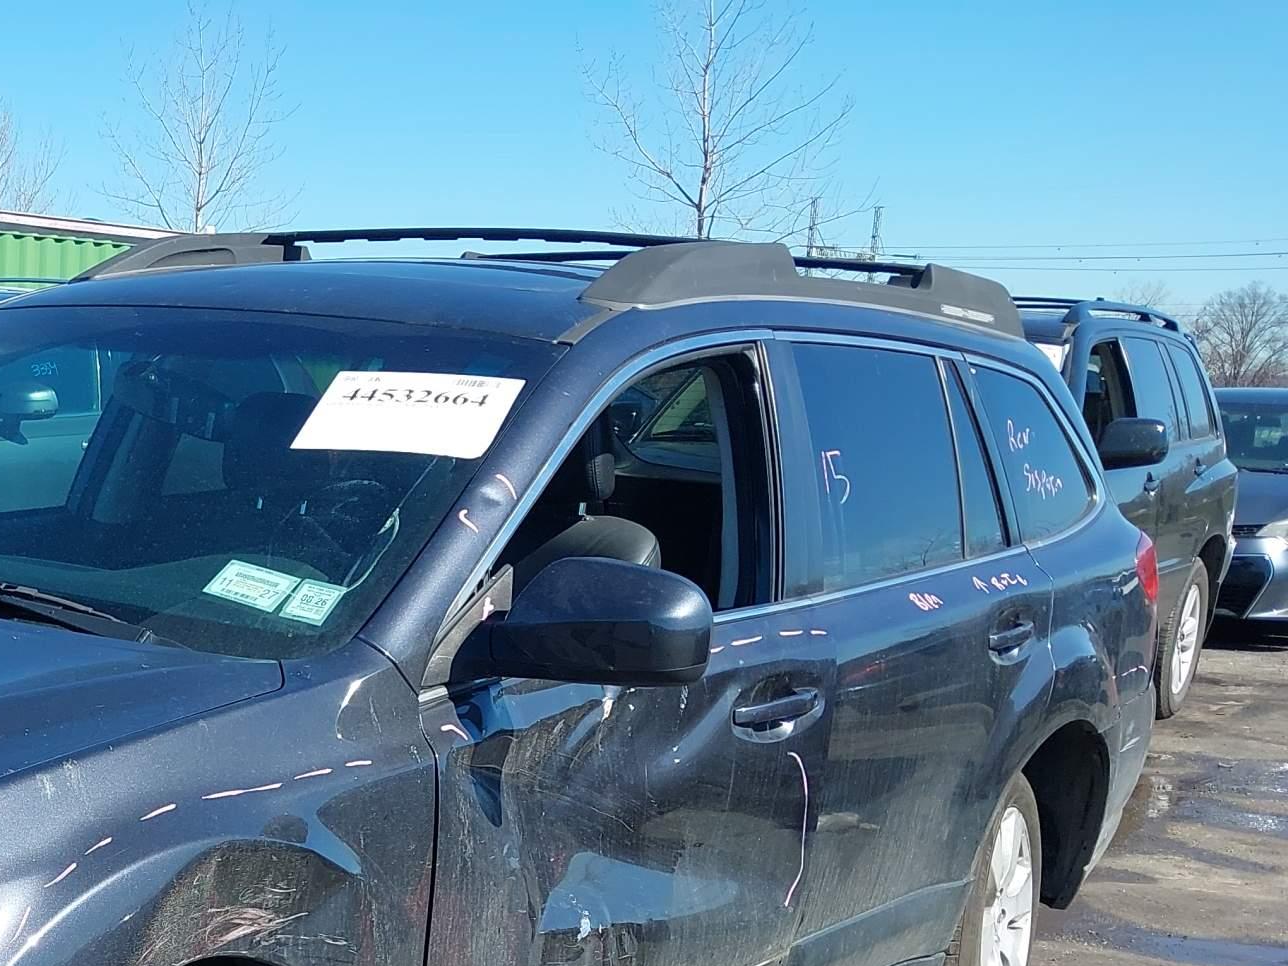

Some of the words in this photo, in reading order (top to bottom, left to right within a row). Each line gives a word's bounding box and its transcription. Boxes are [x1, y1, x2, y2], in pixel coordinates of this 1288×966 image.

[342, 387, 489, 408] 44532664
[820, 450, 851, 505] 15
[217, 576, 234, 588] 11
[258, 588, 280, 601] 27
